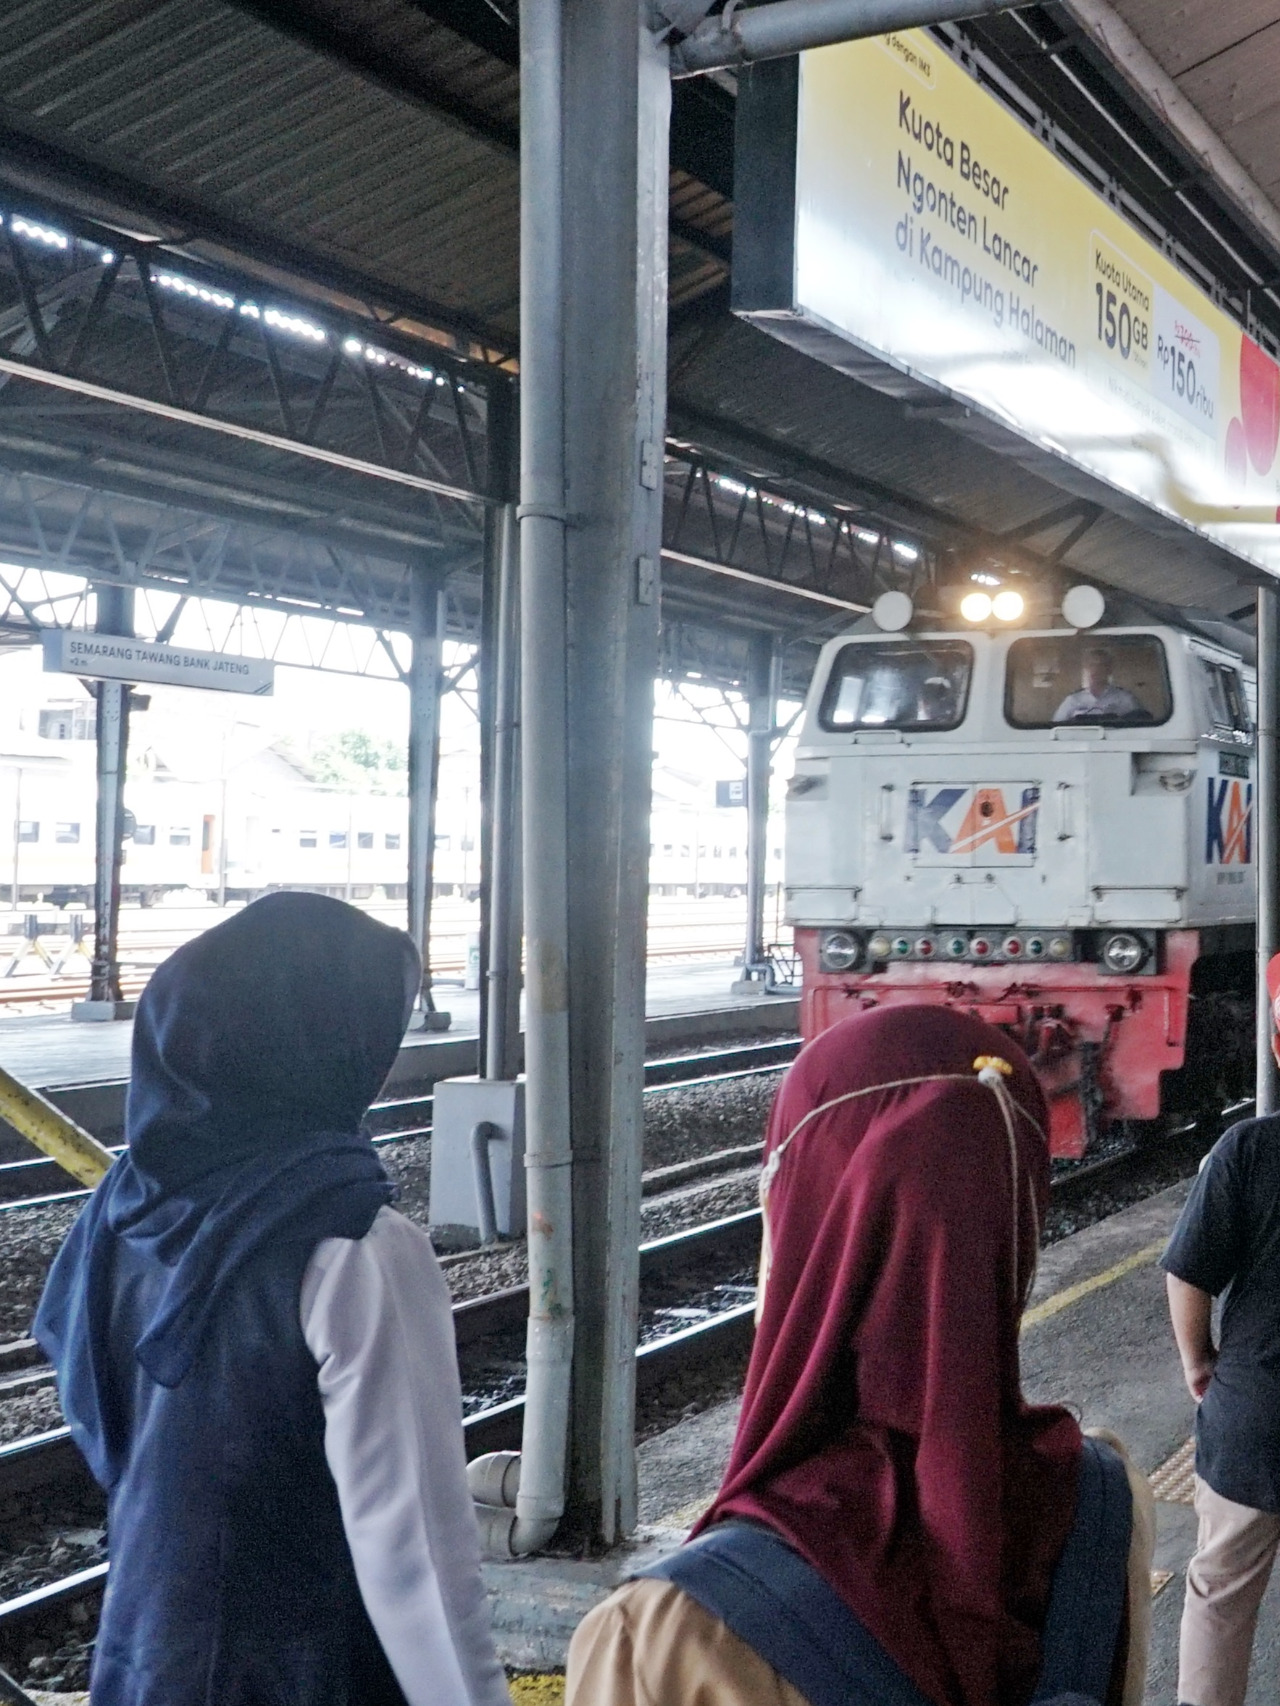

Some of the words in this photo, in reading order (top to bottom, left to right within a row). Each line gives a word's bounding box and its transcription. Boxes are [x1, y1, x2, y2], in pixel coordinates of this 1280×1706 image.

[899, 89, 954, 169] Kuota
[960, 140, 1010, 211] Besar
[897, 150, 978, 245] Ngonten
[982, 216, 1039, 288] Lancar
[895, 213, 914, 258] di
[919, 227, 1004, 329] Kampung
[1009, 291, 1077, 369] Halaman
[1095, 248, 1121, 289] Kuota
[1121, 272, 1150, 313] Utama
[70, 641, 132, 660] SEMARANG
[135, 649, 181, 667] TAWANG
[183, 656, 211, 670] BANK
[212, 660, 250, 676] JATENG
[904, 788, 1041, 854] KAI
[1206, 777, 1253, 865] KAI
